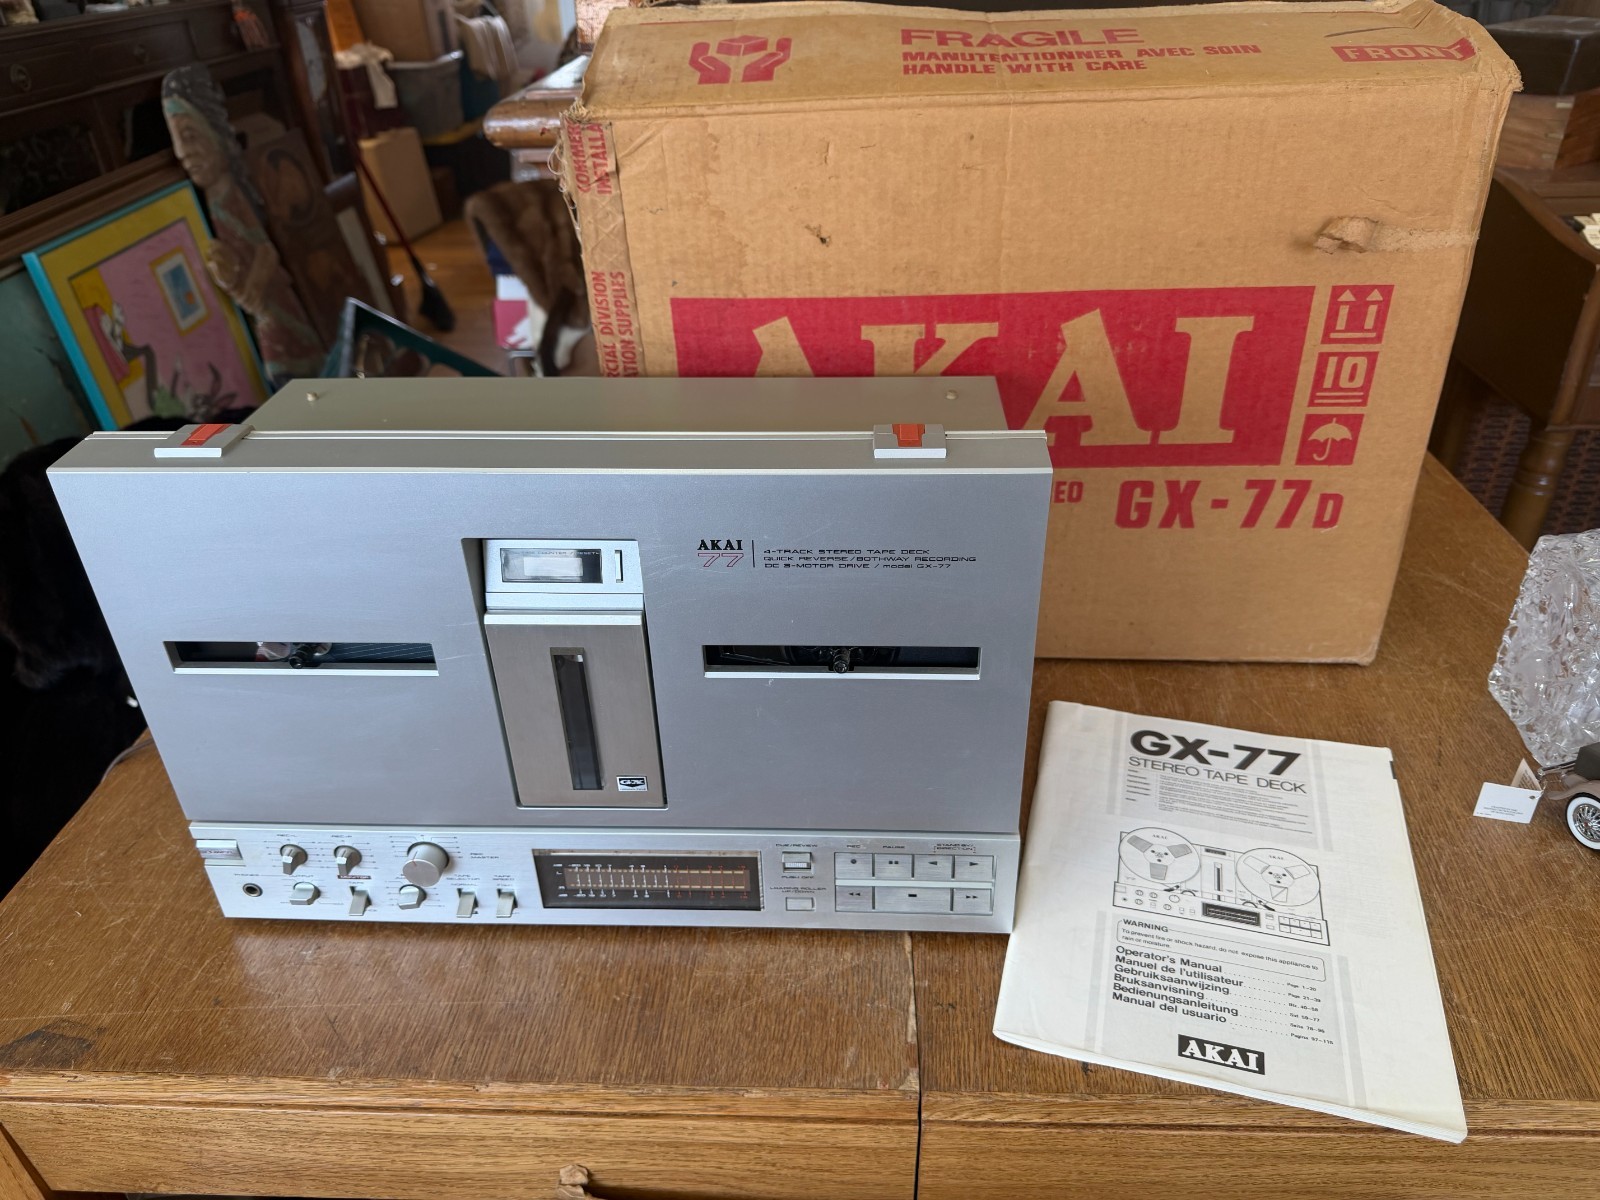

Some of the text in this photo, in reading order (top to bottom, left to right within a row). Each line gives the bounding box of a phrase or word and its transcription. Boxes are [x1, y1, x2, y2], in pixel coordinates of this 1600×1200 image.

[900, 28, 1145, 48] FRAGILE
[902, 44, 1262, 63] MANUTENTIONNER AVEC SOIN
[1342, 45, 1461, 59] FRONT
[903, 59, 1148, 75] HANDLE WITH CARE
[591, 271, 615, 336] DIVISION
[609, 271, 633, 336] SUPPLIES
[1322, 356, 1368, 389] 10
[697, 539, 743, 551] AKAI
[697, 553, 744, 567] 77
[1130, 729, 1302, 776] GX-77
[1128, 756, 1308, 794] STEREO TAPE DECK
[1122, 918, 1169, 933] WARNING
[1115, 945, 1176, 964] Operator's
[1180, 957, 1222, 972] Manual
[1130, 930, 1154, 939] prevent
[1240, 951, 1264, 960] expose
[1278, 959, 1311, 969] appliance
[1113, 973, 1205, 1000] Bruksanvisning
[1114, 963, 1230, 995] Gebruiksaanwijzing
[1115, 954, 1157, 970] Manuel
[1161, 965, 1176, 974] de
[1180, 967, 1244, 987] l'utilisateur
[1112, 982, 1239, 1017] Bedienungsanleitung
[1112, 991, 1156, 1008] Manual
[1159, 1002, 1178, 1013] del
[1181, 1008, 1227, 1024] usuario
[1181, 1039, 1259, 1072] AKAI
